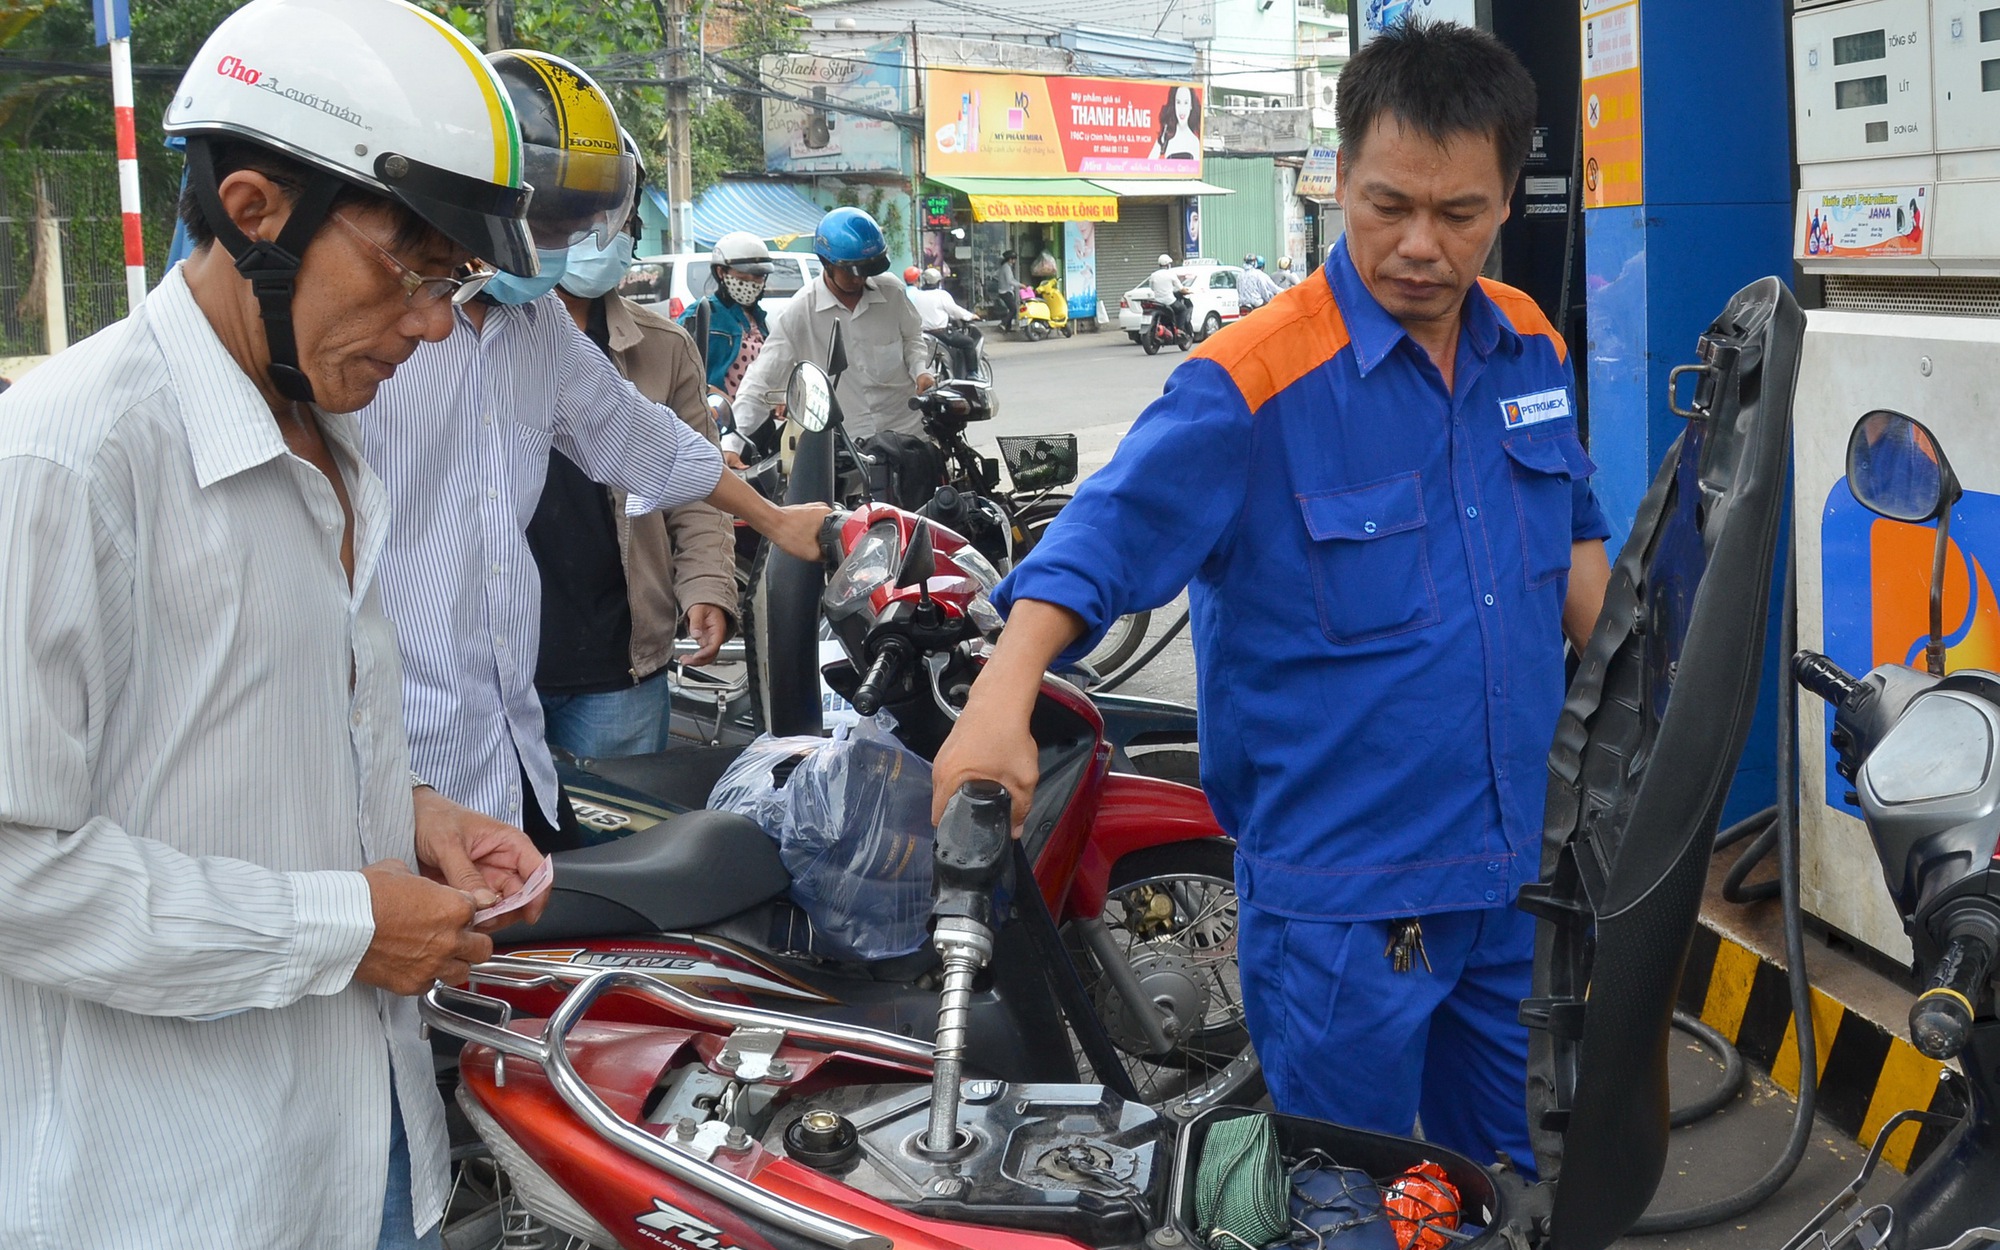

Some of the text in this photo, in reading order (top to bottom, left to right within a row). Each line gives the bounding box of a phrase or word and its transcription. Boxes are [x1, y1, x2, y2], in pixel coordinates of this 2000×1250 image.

[217, 55, 262, 85] Chợ
[771, 58, 817, 77] Black
[820, 59, 858, 82] Style
[1899, 78, 1910, 92] LÍT
[1071, 101, 1151, 128] THANH HẰNG
[569, 138, 618, 151] HONDA
[1073, 201, 1100, 217] LÔNG
[1102, 205, 1115, 217] MI
[1868, 207, 1892, 219] JANA
